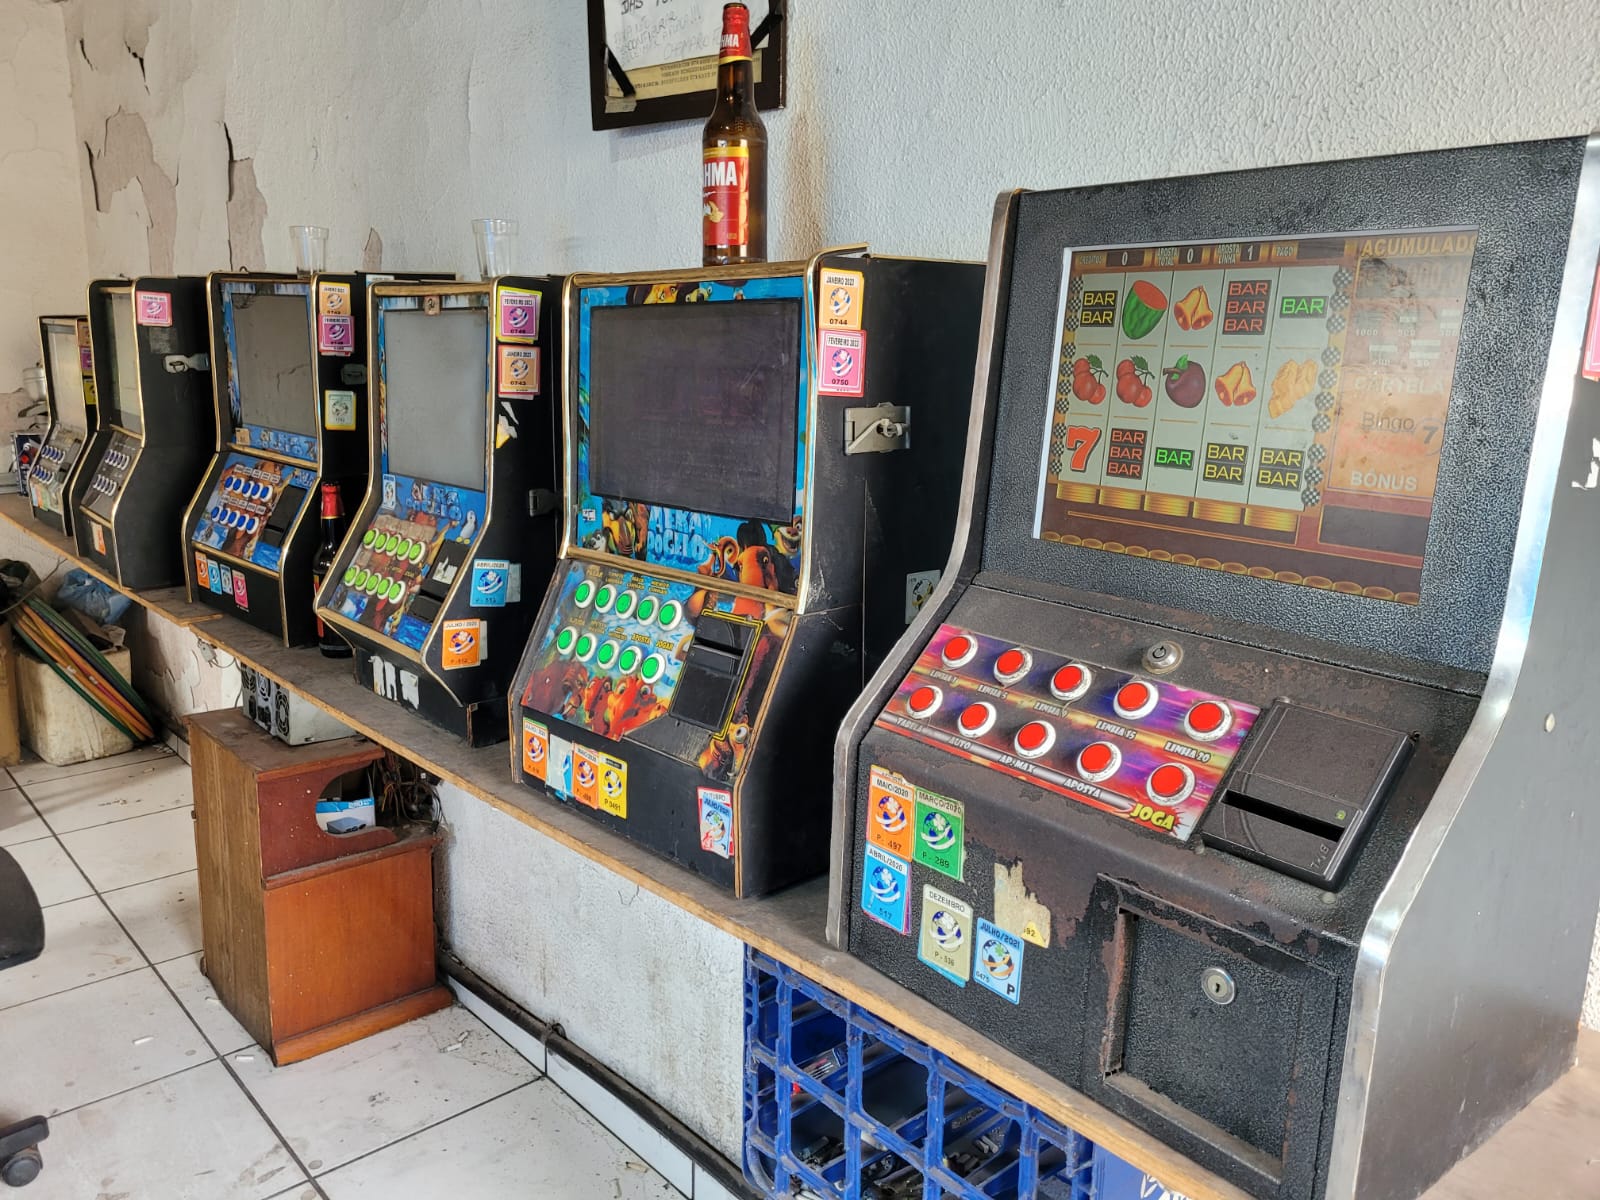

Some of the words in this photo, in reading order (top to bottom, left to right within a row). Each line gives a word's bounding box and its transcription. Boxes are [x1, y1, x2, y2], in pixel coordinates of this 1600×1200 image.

[1121, 251, 1128, 266] 0
[1187, 248, 1194, 263] 0
[1247, 244, 1254, 260] 1
[1229, 283, 1268, 296] BAR
[1084, 293, 1115, 306] BAR
[1226, 301, 1265, 314] BAR
[1282, 298, 1324, 314] BAR
[1081, 311, 1112, 324] BAR
[1223, 319, 1262, 332] BAR
[1361, 411, 1415, 433] Bingo
[1423, 426, 1439, 444] 7
[1112, 430, 1144, 444] BAR
[1110, 446, 1143, 460] BAR
[1156, 449, 1192, 466] BAR
[1208, 445, 1244, 462] BAR
[1261, 450, 1301, 467] BAR
[1107, 462, 1141, 476] BAR
[1205, 464, 1242, 480] BAR
[1259, 470, 1298, 487] BAR
[1096, 720, 1125, 737] LINHA
[1125, 731, 1137, 741] 15
[1164, 741, 1196, 759] LINHA
[1196, 752, 1211, 763] 20
[948, 736, 971, 750] AUTO
[1063, 778, 1101, 799] APOSTA
[1130, 803, 1175, 830] JOGA
[929, 890, 966, 913] DEZEMBRO
[980, 921, 1020, 950] JULHO/2021
[1006, 983, 1016, 995] P
